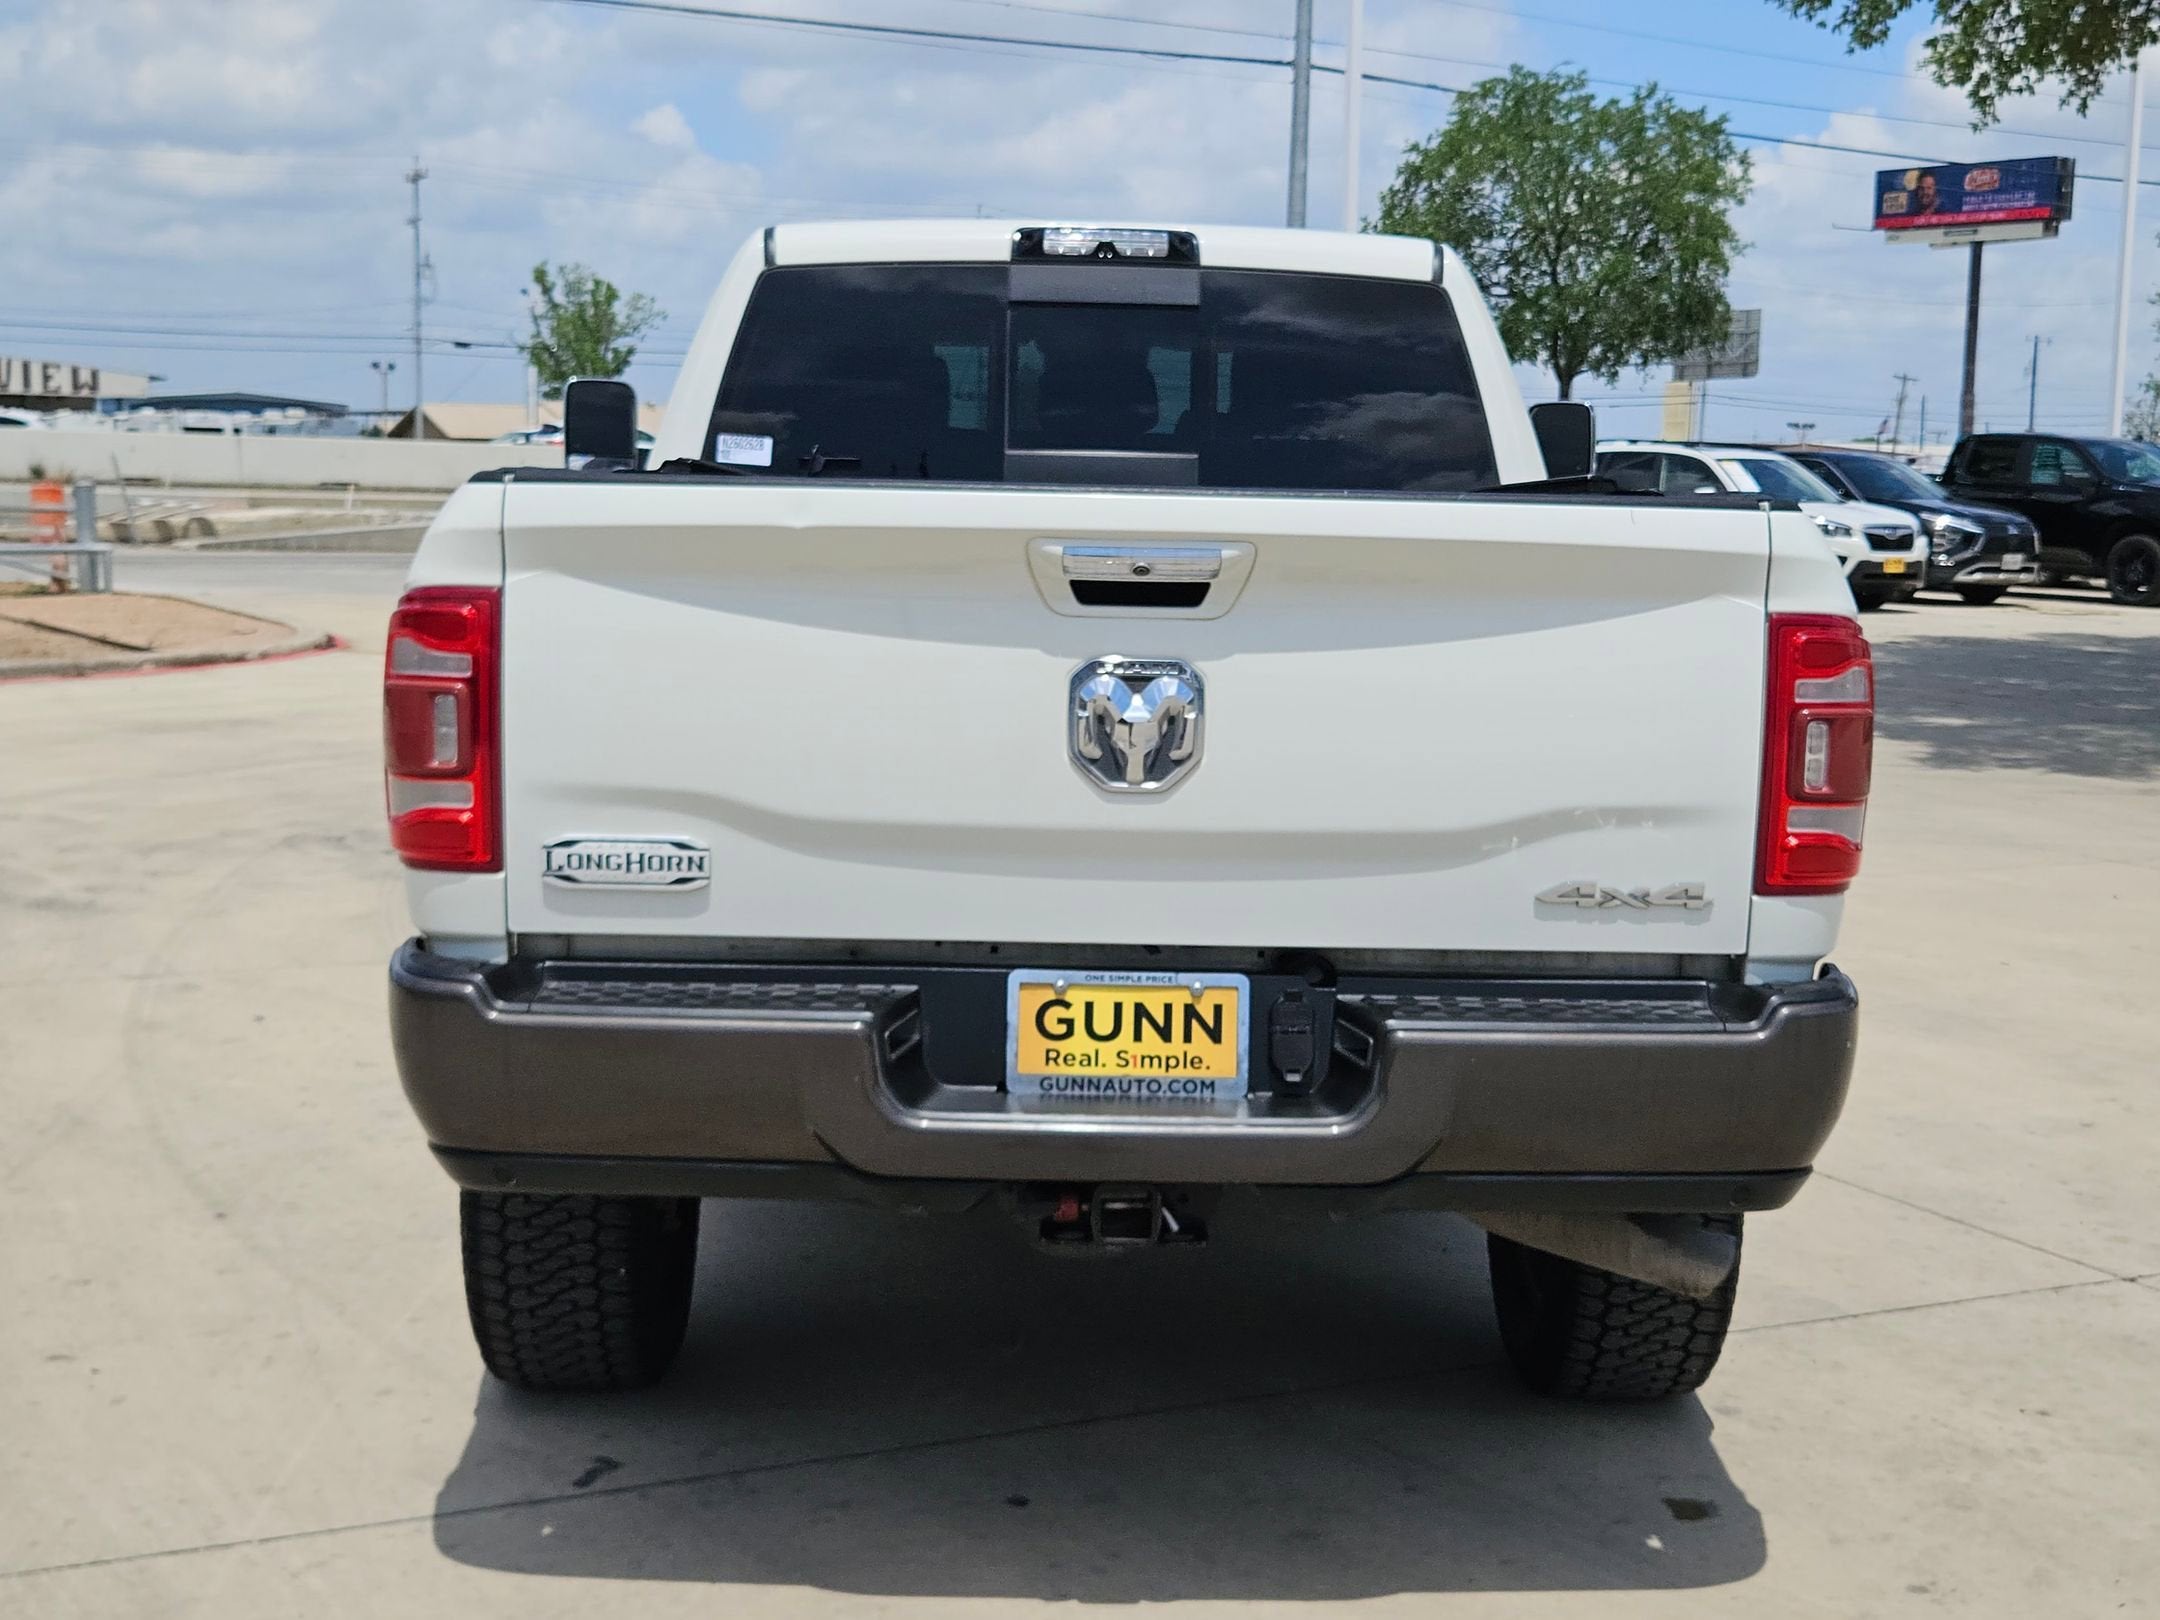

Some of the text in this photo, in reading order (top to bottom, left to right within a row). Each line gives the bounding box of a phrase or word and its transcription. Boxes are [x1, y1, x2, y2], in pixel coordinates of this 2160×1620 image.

[1084, 974, 1174, 984] ONE SIMPLE PRICE
[1034, 998, 1223, 1045] GUNN
[1044, 1048, 1107, 1068] Real.
[1039, 1076, 1216, 1094] GUNNAUTO.COM
